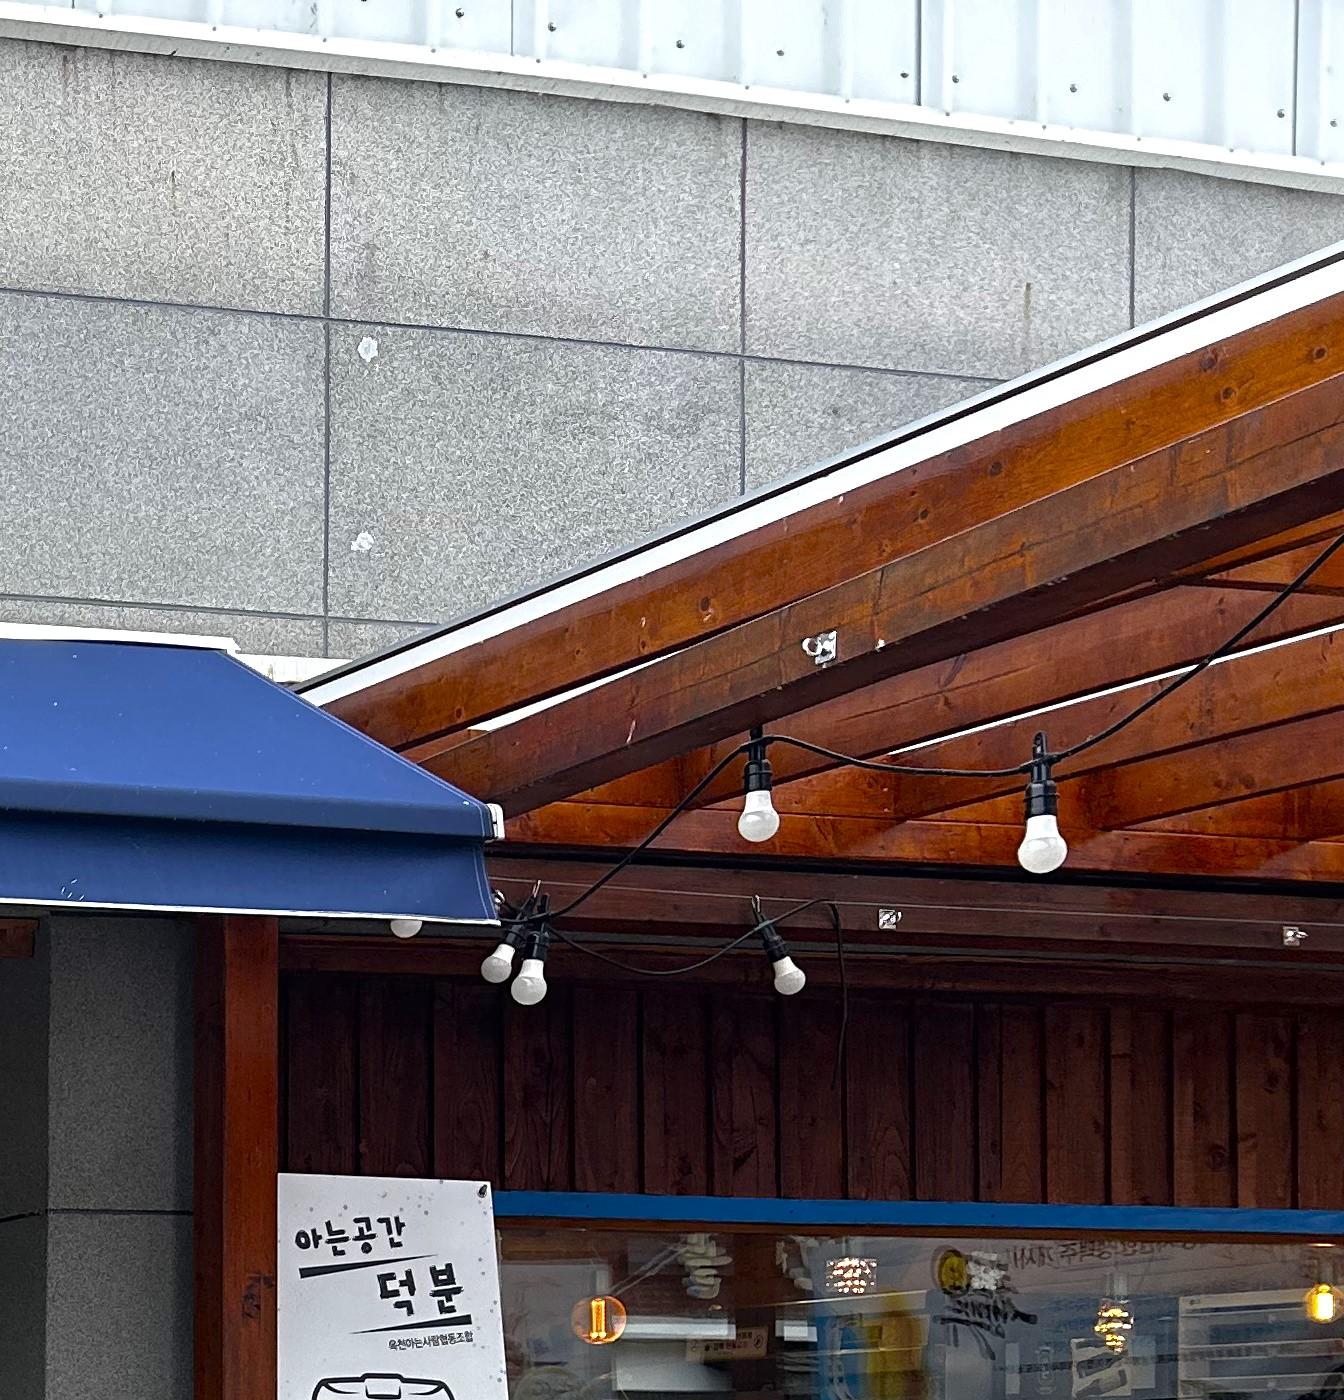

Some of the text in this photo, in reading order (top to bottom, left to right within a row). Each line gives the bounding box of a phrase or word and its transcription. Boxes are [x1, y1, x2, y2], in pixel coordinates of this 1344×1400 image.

[294, 1215, 406, 1256] 아는공간
[377, 1262, 464, 1316] 덕분
[388, 1331, 474, 1351] 옥천아는사람협동조합
